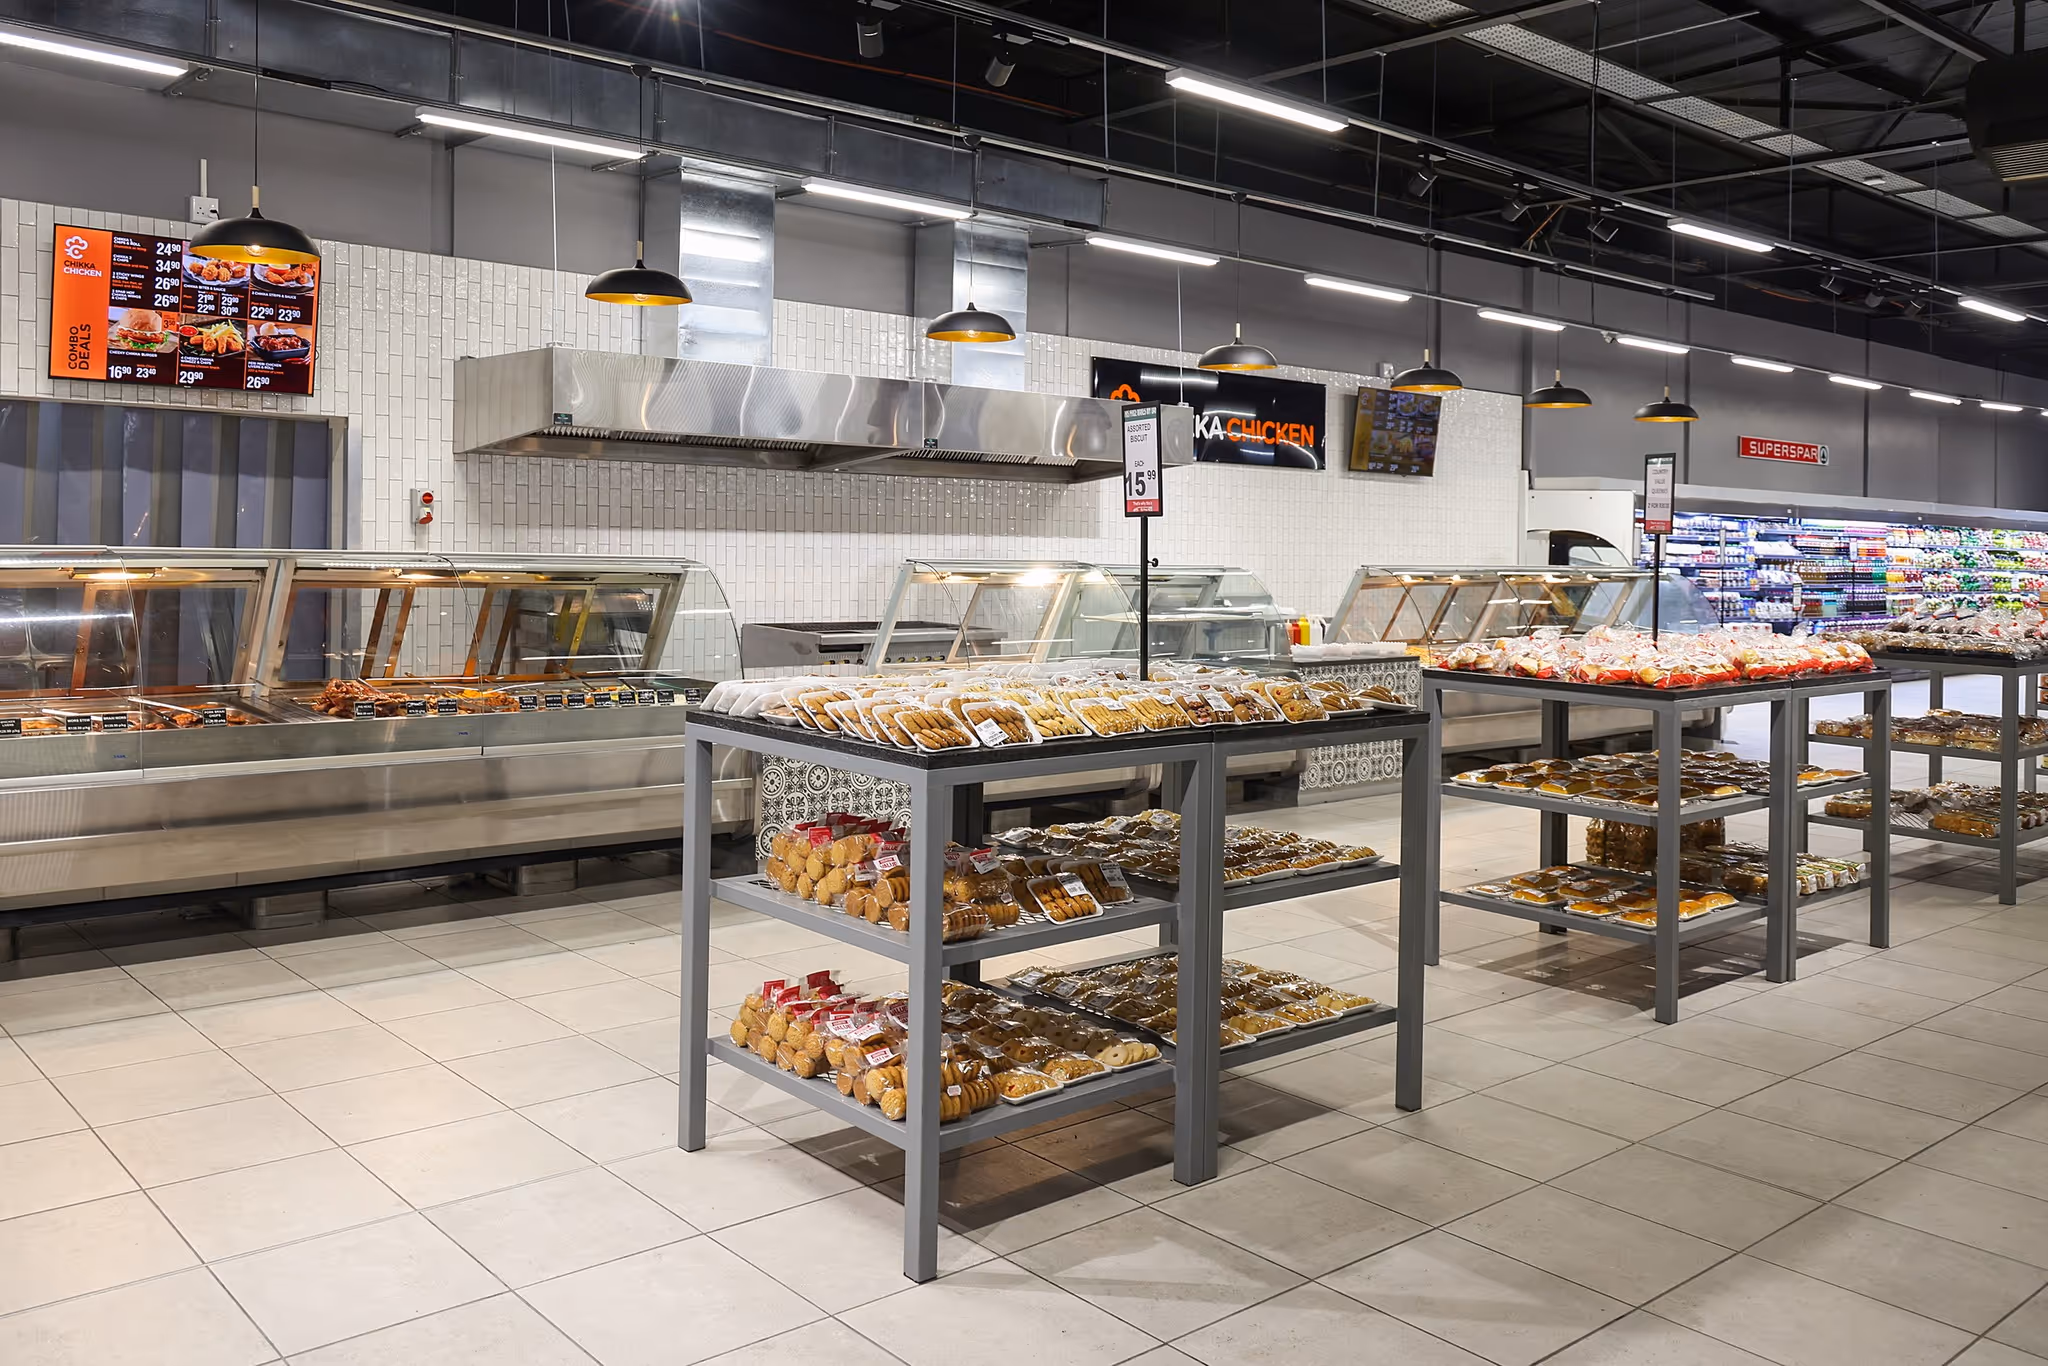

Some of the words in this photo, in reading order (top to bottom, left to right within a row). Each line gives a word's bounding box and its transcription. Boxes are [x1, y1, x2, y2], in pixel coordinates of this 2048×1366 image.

[64, 260, 95, 269] CHIKKA
[63, 267, 102, 277] CHICKEN
[68, 326, 79, 370] COMBO
[78, 324, 92, 371] DEALS
[1127, 423, 1151, 432] ASSORTED
[1226, 417, 1315, 448] CHICKEN
[1130, 434, 1148, 443] BISCUIT
[1749, 441, 1818, 460] SUPERSPAR
